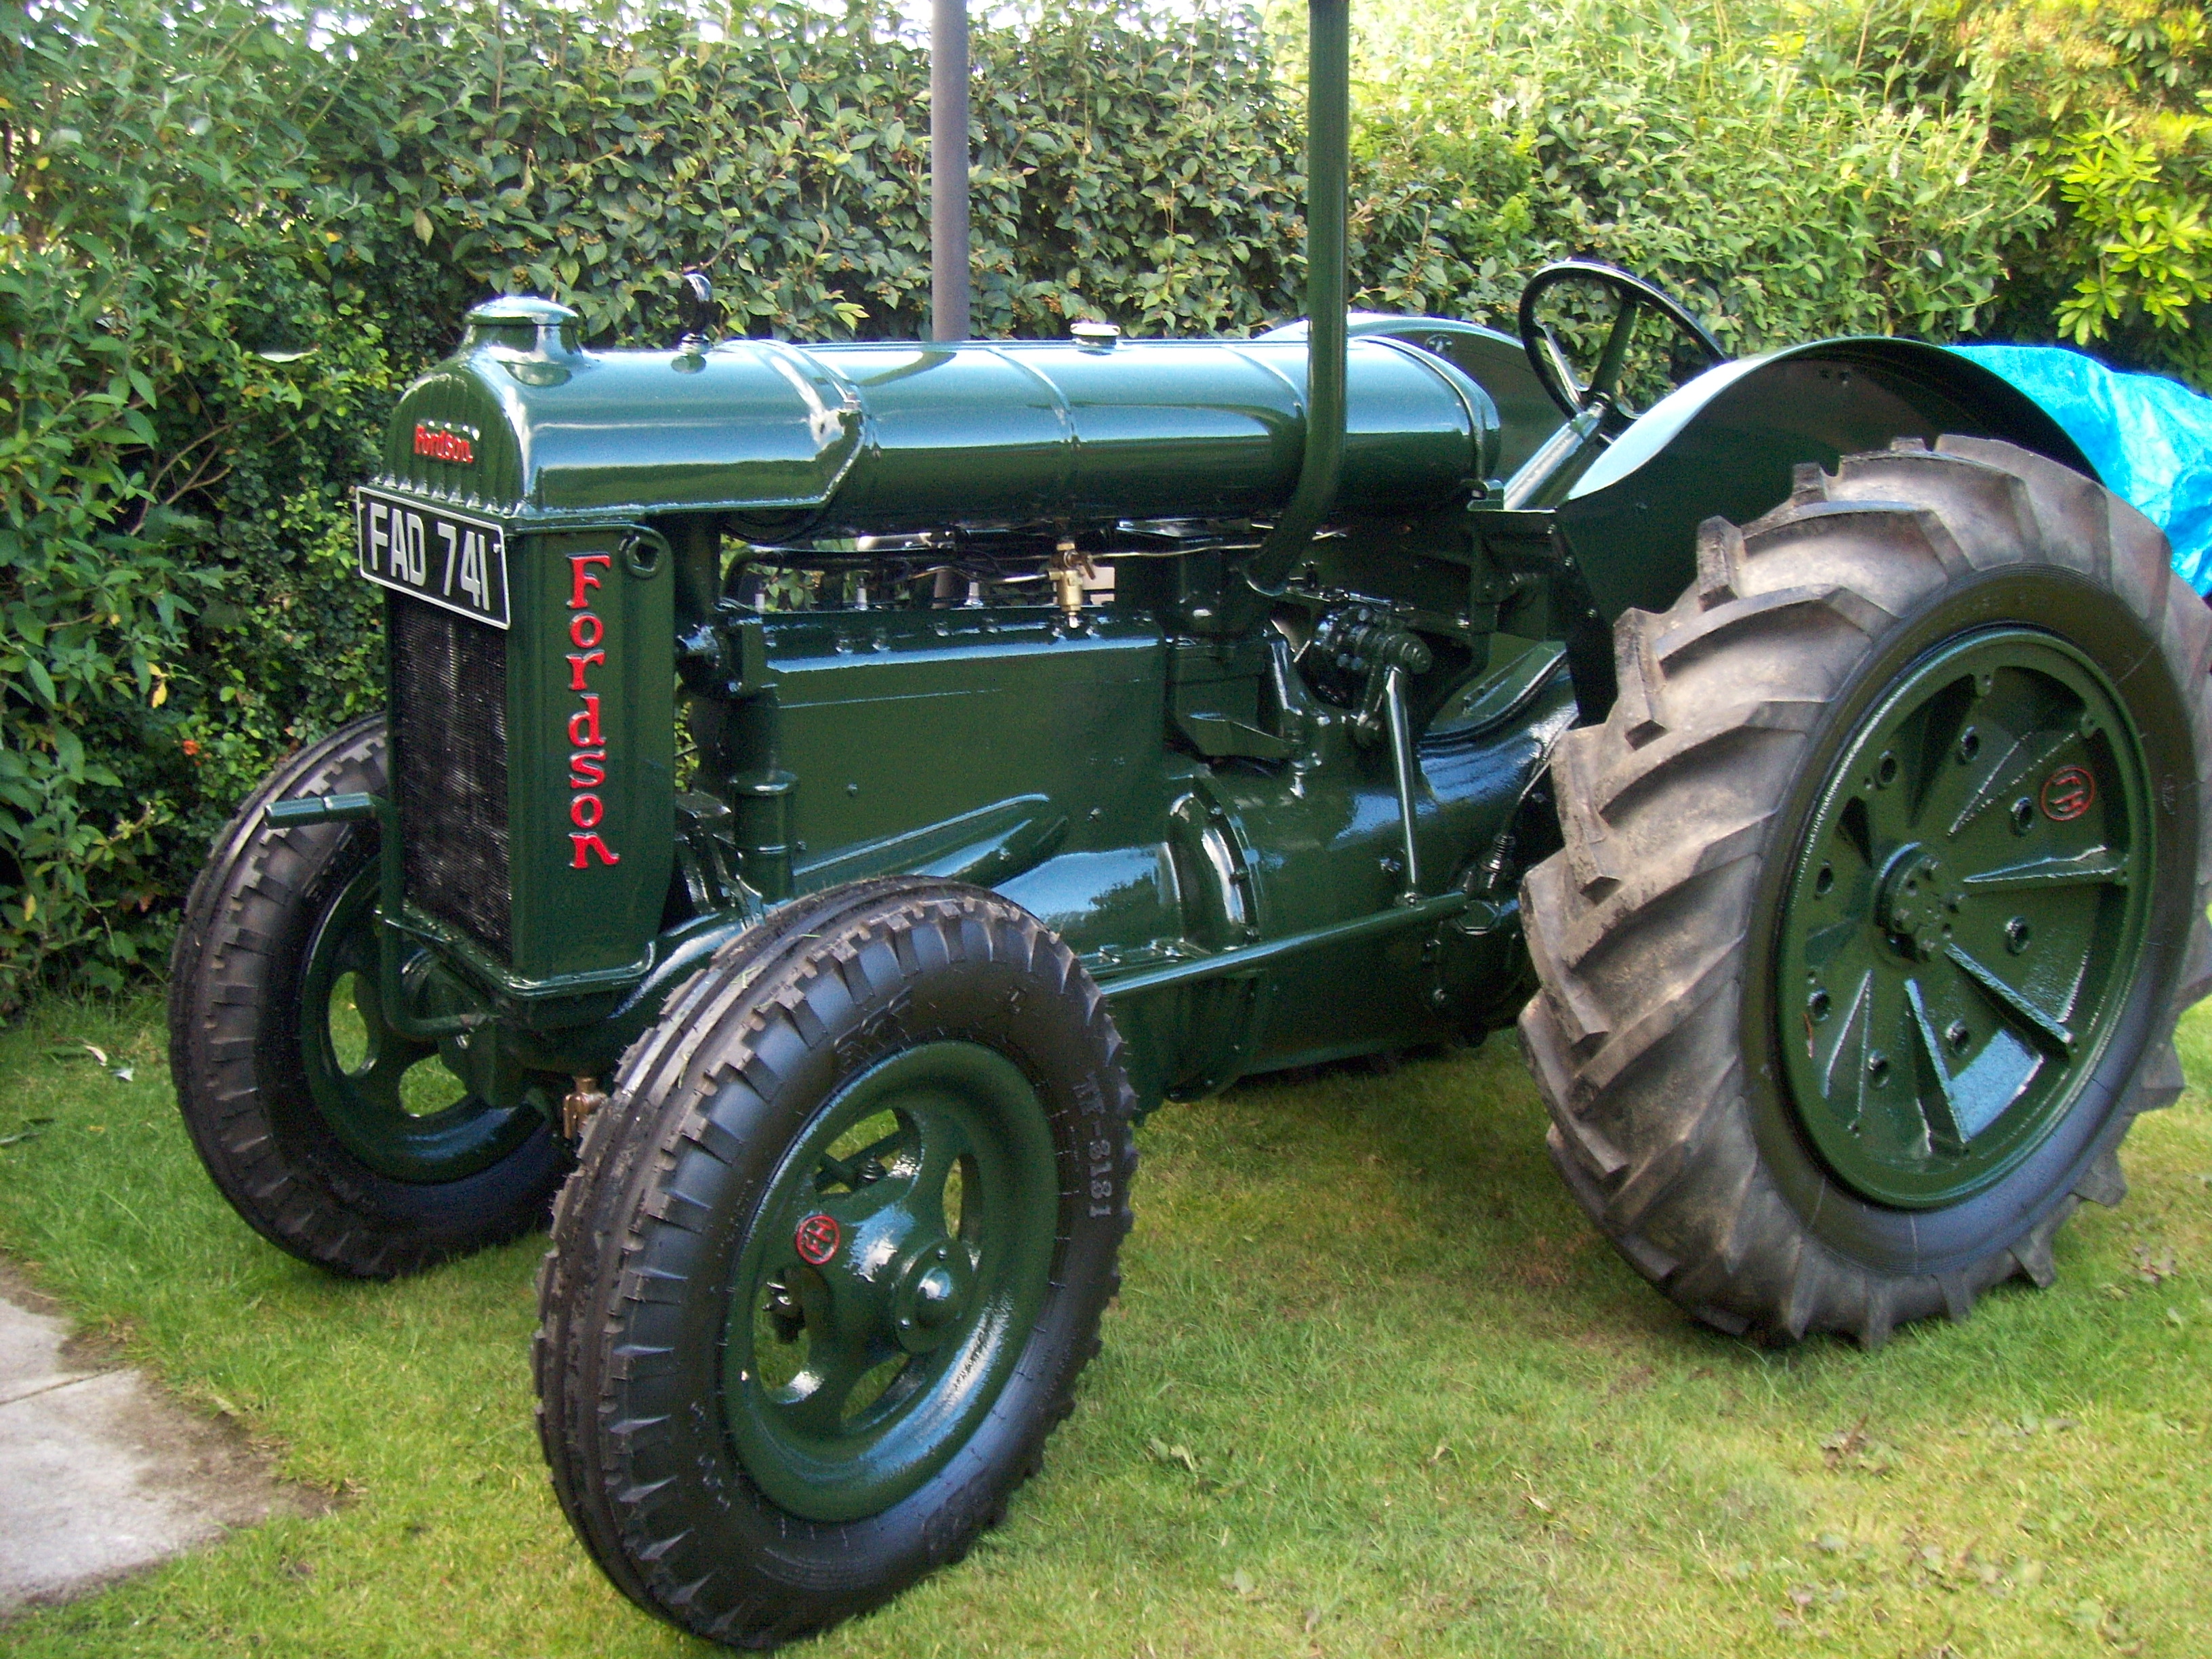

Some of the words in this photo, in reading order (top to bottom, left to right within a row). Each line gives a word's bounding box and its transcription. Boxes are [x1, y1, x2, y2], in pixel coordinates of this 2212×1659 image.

[414, 424, 474, 464] Fordson
[370, 502, 426, 587] FAD
[437, 521, 490, 611] 741
[565, 551, 620, 869] Fordson
